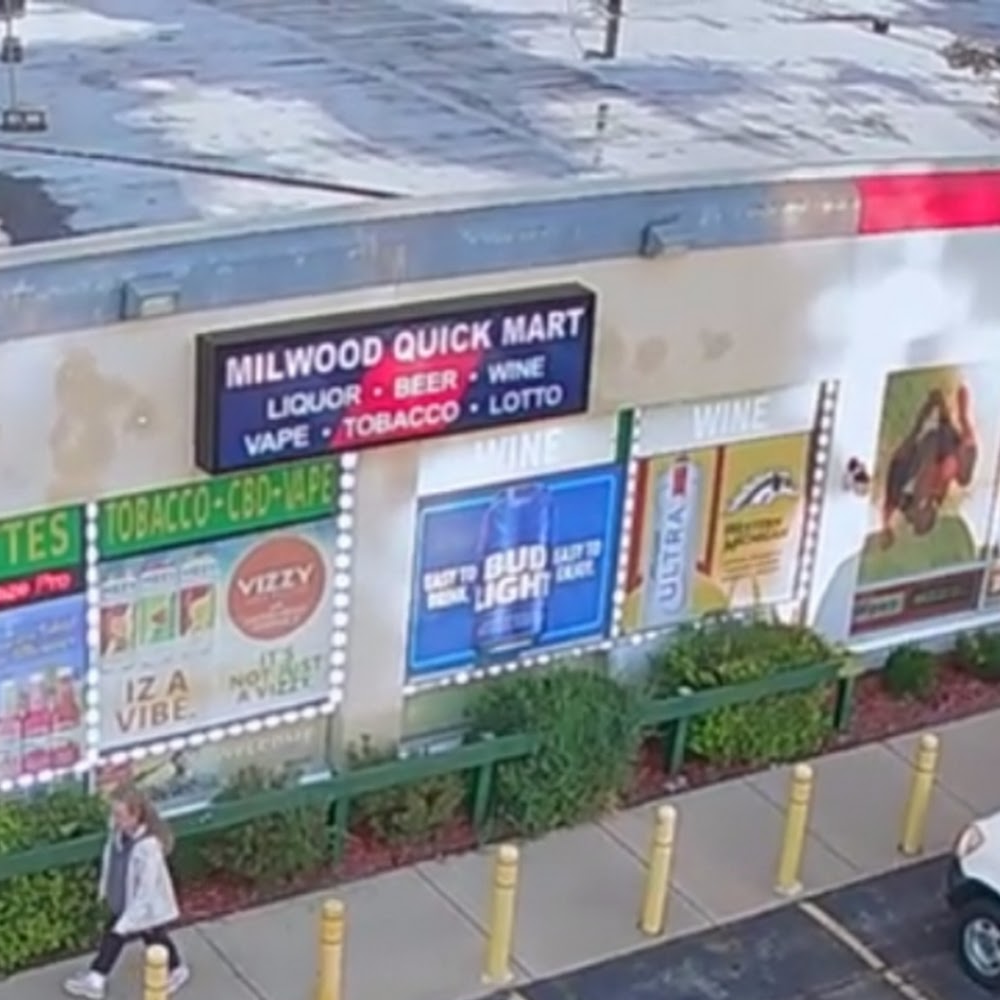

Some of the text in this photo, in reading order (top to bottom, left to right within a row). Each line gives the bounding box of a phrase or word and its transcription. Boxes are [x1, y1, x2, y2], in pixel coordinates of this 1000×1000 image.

[225, 307, 584, 388] MILWOOD QUICK MART
[267, 356, 545, 420] LIQUOR BEER WINE
[244, 385, 563, 458] VAPE TOBACCO LOTTO
[692, 396, 770, 435] WINE
[474, 428, 562, 468] WINE
[106, 485, 210, 544] TOBACCO
[483, 544, 548, 582] BUD
[658, 505, 686, 602] ULTRA
[237, 564, 315, 597] VIZZY
[474, 570, 551, 613] LIGHT
[126, 669, 189, 703] IZ A
